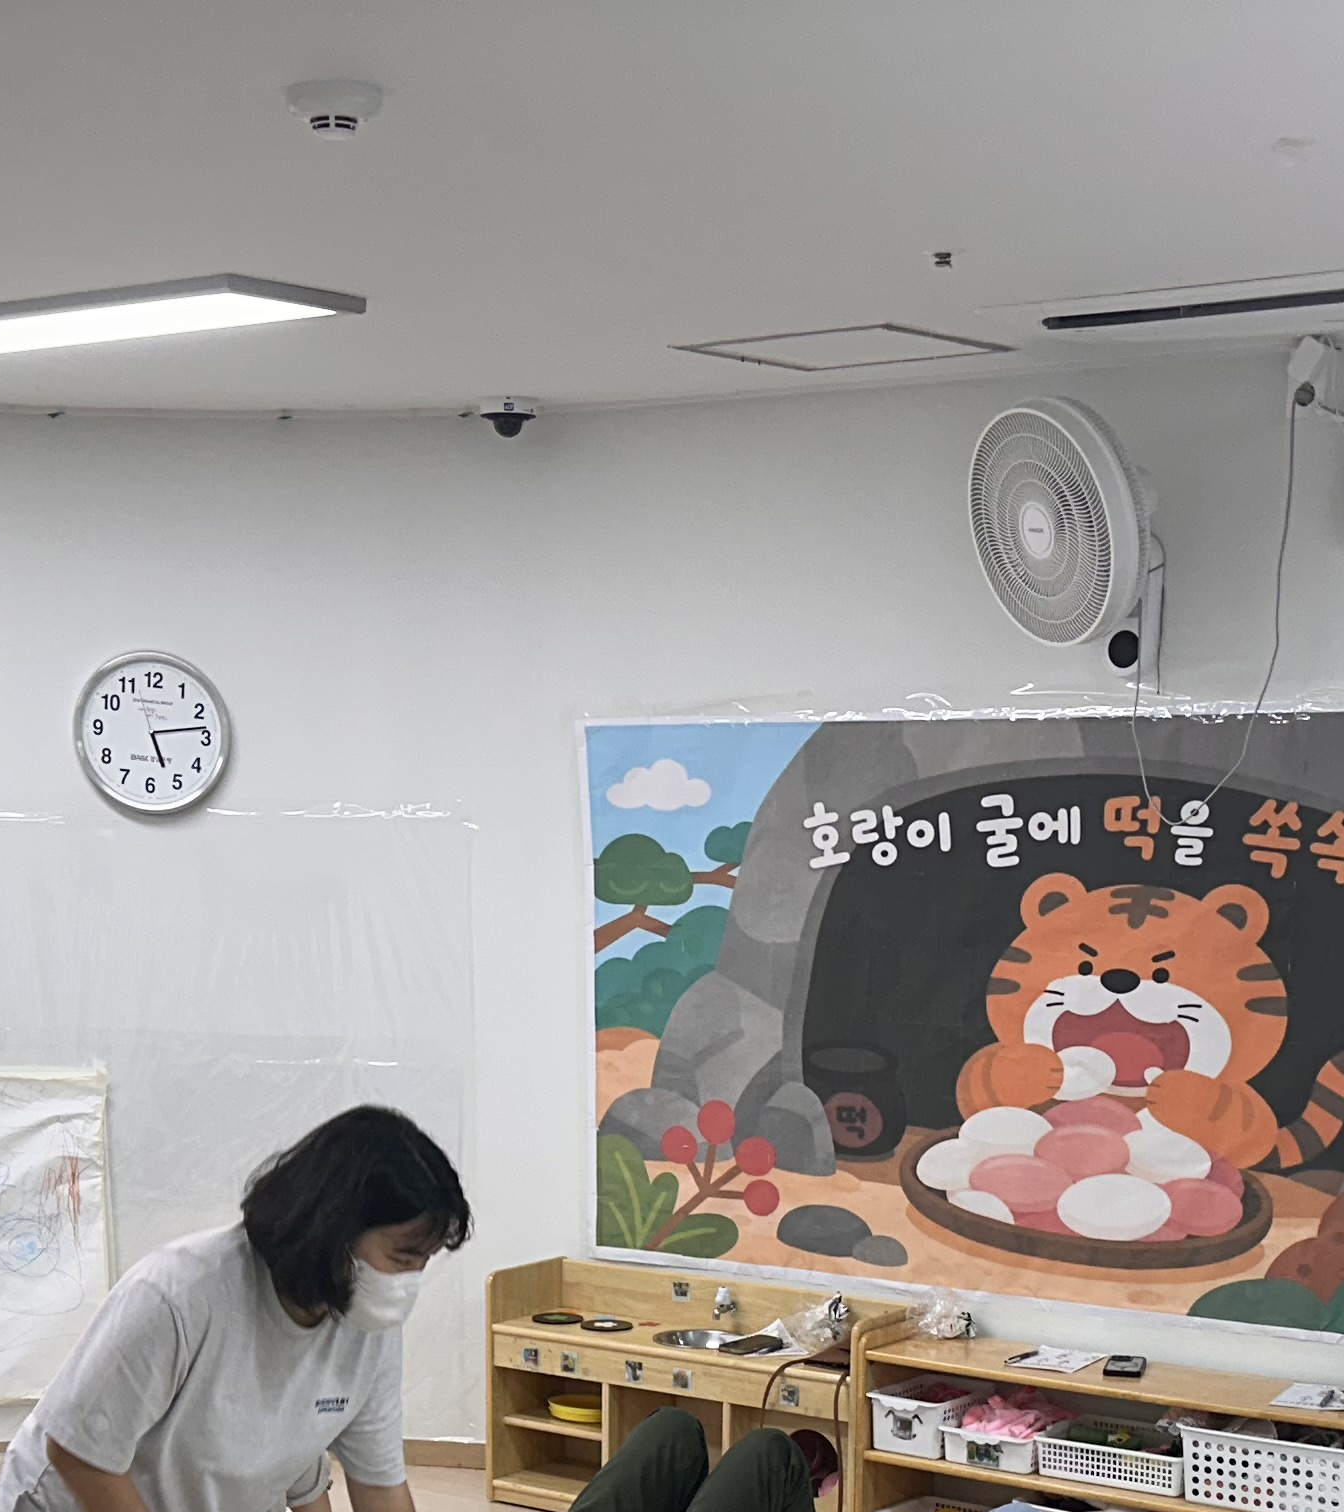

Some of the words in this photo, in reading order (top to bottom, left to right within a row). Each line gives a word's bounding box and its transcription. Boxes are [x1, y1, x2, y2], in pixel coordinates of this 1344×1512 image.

[118, 677, 135, 694] 11
[144, 672, 163, 689] 12
[178, 683, 186, 699] 1
[101, 694, 121, 711] 10
[194, 703, 205, 720] 2
[93, 719, 104, 736] 9
[200, 730, 212, 747] 3
[101, 748, 112, 764] 8
[191, 757, 202, 773] 4
[119, 768, 131, 785] 7
[145, 777, 156, 793] 6
[172, 774, 183, 790] 5
[803, 802, 952, 868] 호랑이
[976, 794, 1081, 868] 굴에
[1103, 795, 1214, 866] 떡을
[836, 1106, 867, 1140] 떡
